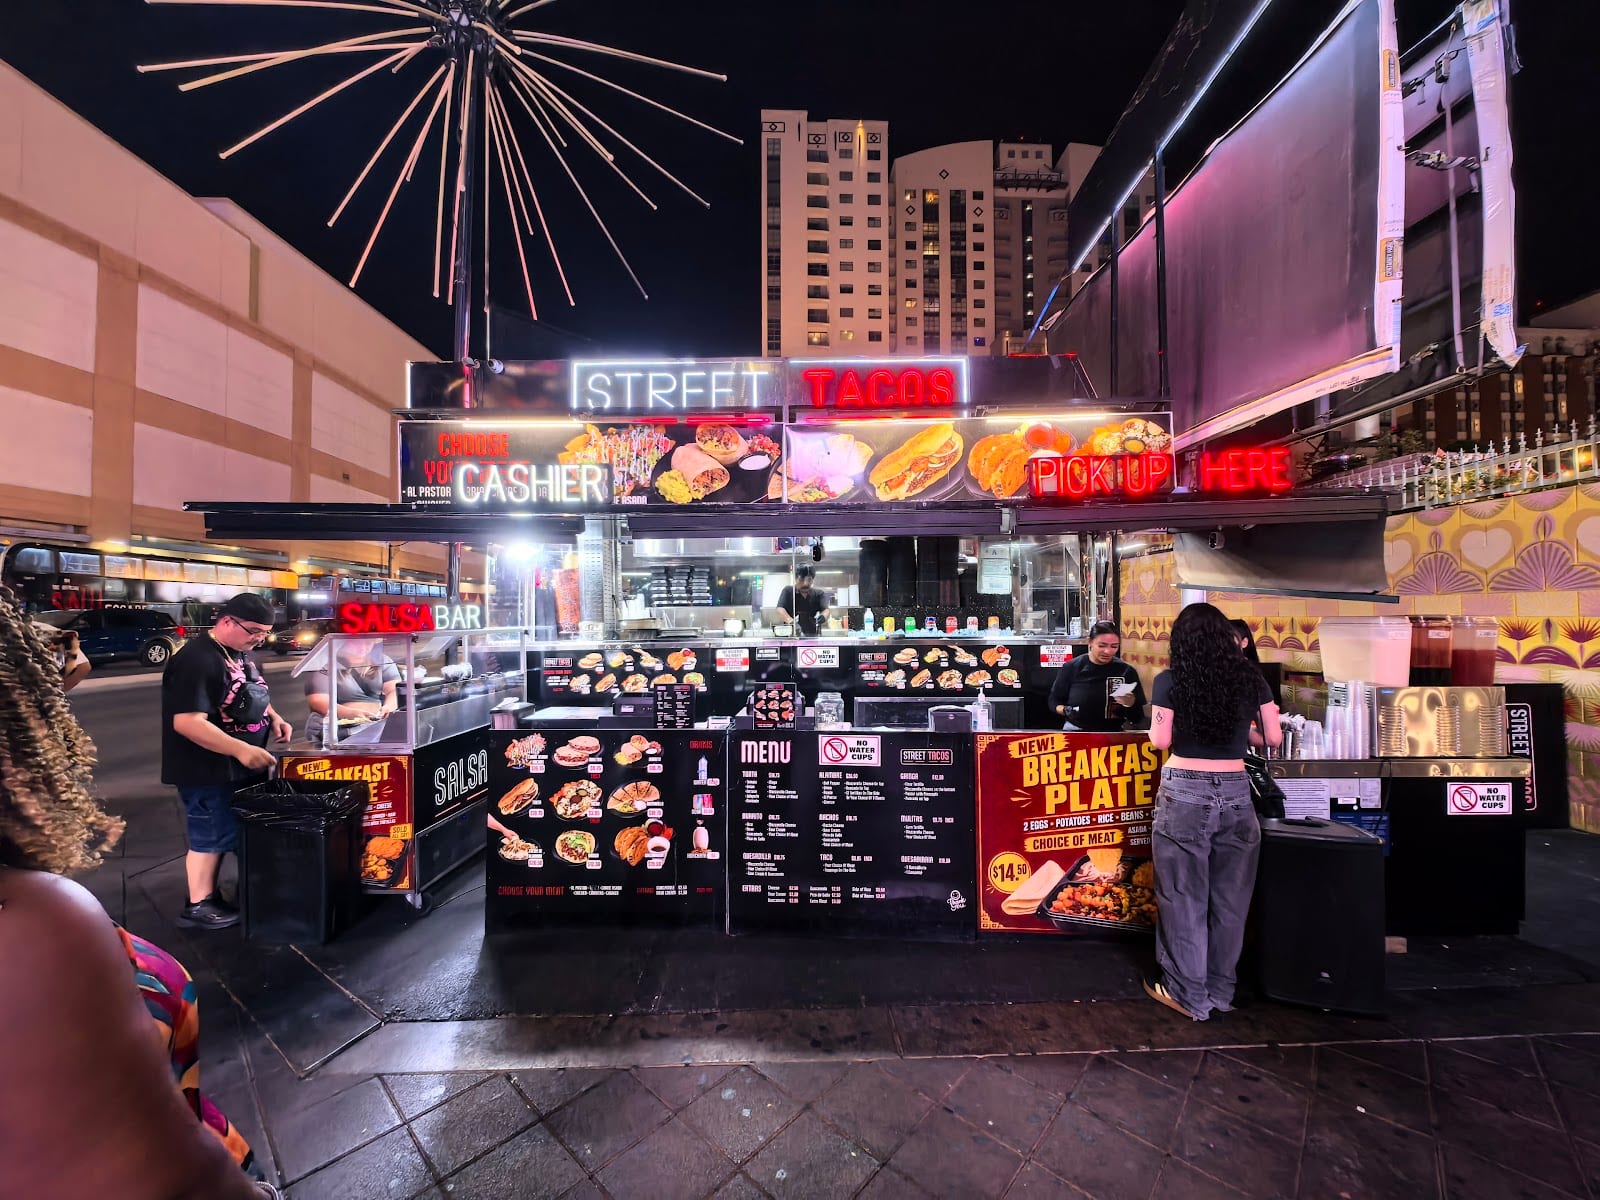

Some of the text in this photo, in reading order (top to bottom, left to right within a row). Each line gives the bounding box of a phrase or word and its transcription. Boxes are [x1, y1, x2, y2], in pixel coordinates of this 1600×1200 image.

[586, 367, 955, 409] STREET TACOS
[438, 432, 510, 457] CHOOSE
[1034, 447, 1292, 497] PICK UP HERE
[407, 486, 452, 497] AL PASTOR
[456, 463, 605, 504] CASHIER
[341, 602, 481, 633] SALSA BAR
[1509, 708, 1530, 756] STREET
[689, 740, 713, 749] DRINKS
[741, 740, 791, 764] MENU
[1017, 735, 1056, 756] NEW!
[903, 750, 950, 760] STREET TACOS
[302, 760, 324, 773] NEW!
[434, 749, 488, 806] SALSA
[1045, 773, 1153, 815] PLATE
[1481, 801, 1504, 809] CUPS
[900, 815, 923, 823] MULITAS
[1023, 810, 1144, 831] 2 EGGS POTATOES RICE BEANS
[392, 825, 408, 834] SOLD
[1032, 831, 1116, 850] CHOICE OF MEAT
[820, 853, 833, 861] TACO
[992, 863, 1027, 883] $14.50
[498, 886, 565, 896] CHOOSE YOUR MEAT
